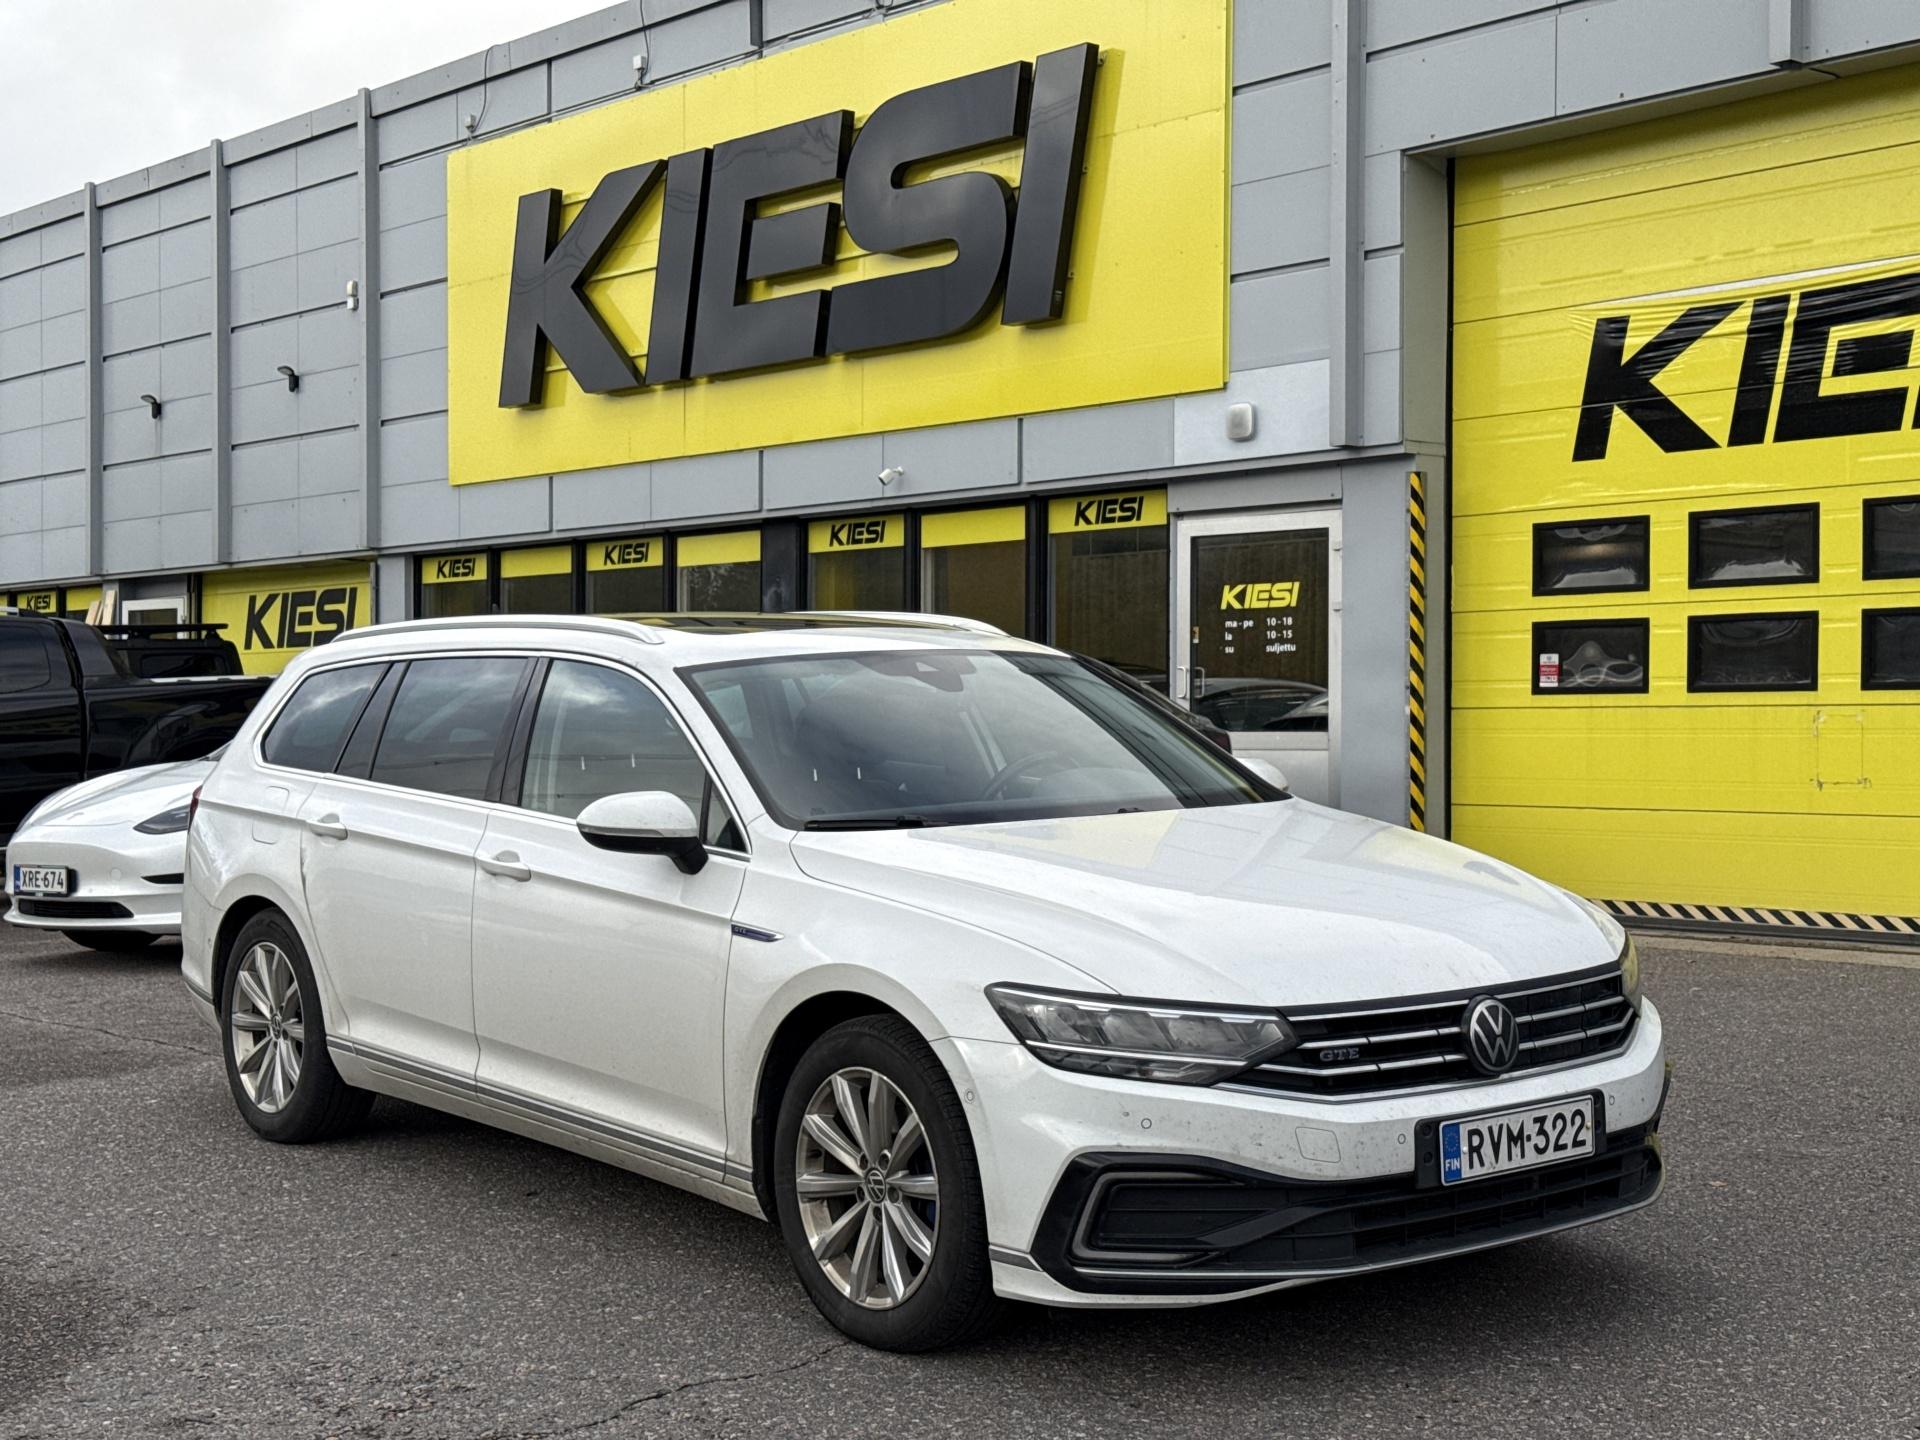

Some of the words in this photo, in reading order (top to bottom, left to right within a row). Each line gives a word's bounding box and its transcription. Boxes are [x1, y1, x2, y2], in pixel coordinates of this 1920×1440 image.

[499, 42, 1099, 408] KIESI
[1572, 272, 1920, 462] KIE
[1074, 496, 1144, 526] KIESI
[829, 520, 886, 547] KIESI
[603, 542, 650, 566] KIESI
[436, 558, 476, 579] KIESI
[1221, 581, 1300, 610] KIESI
[244, 587, 358, 650] KIESI
[1266, 617, 1277, 626] 10
[1225, 631, 1233, 641] la
[1266, 630, 1277, 639] 10
[1282, 629, 1293, 639] 15
[1224, 645, 1235, 653] su
[1265, 642, 1296, 654] suljettu
[22, 870, 64, 889] XRE-674
[1320, 1047, 1359, 1061] GTE
[1467, 1108, 1587, 1170] RVM-322
[1445, 1157, 1461, 1172] FIN
